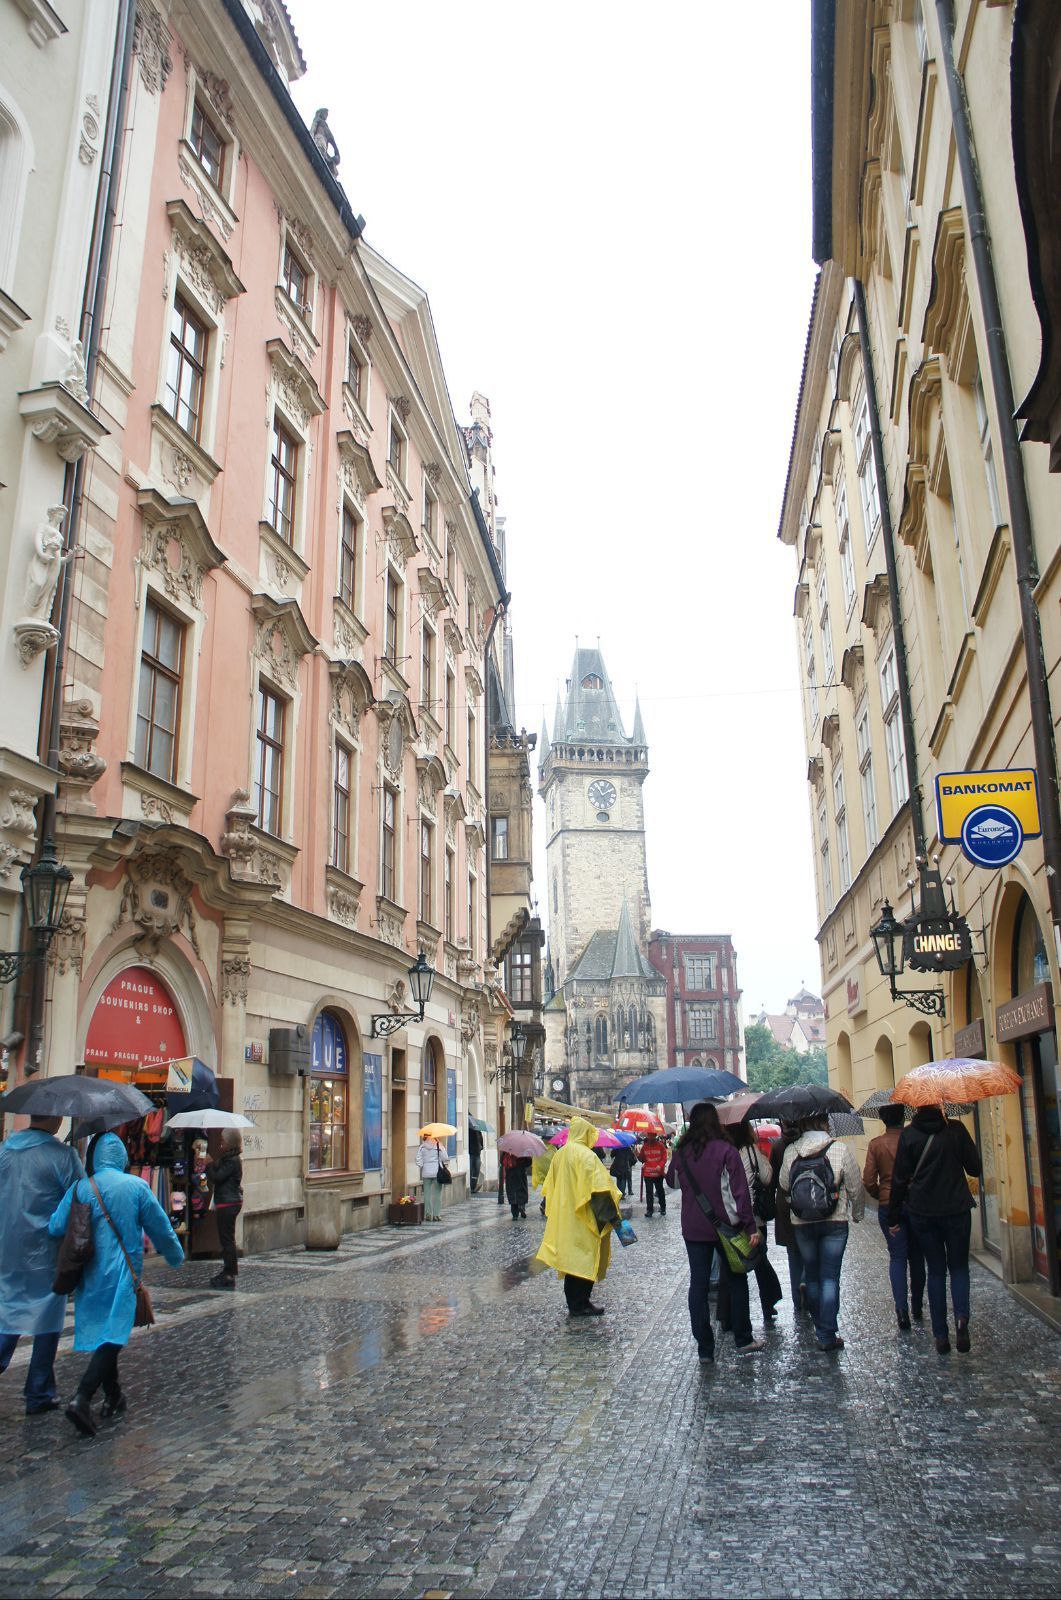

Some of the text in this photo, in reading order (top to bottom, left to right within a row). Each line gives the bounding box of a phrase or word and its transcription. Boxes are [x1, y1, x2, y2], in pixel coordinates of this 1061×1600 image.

[942, 781, 1032, 795] BANKOMAT
[977, 824, 1007, 833] Euronet
[914, 933, 961, 952] CHANGE
[121, 981, 154, 995] PRAGUE
[101, 996, 172, 1015] SOUVENIRS SHOP
[136, 1016, 141, 1024] &
[86, 1049, 108, 1057] PRAHA
[114, 1052, 139, 1060] PRAGUE
